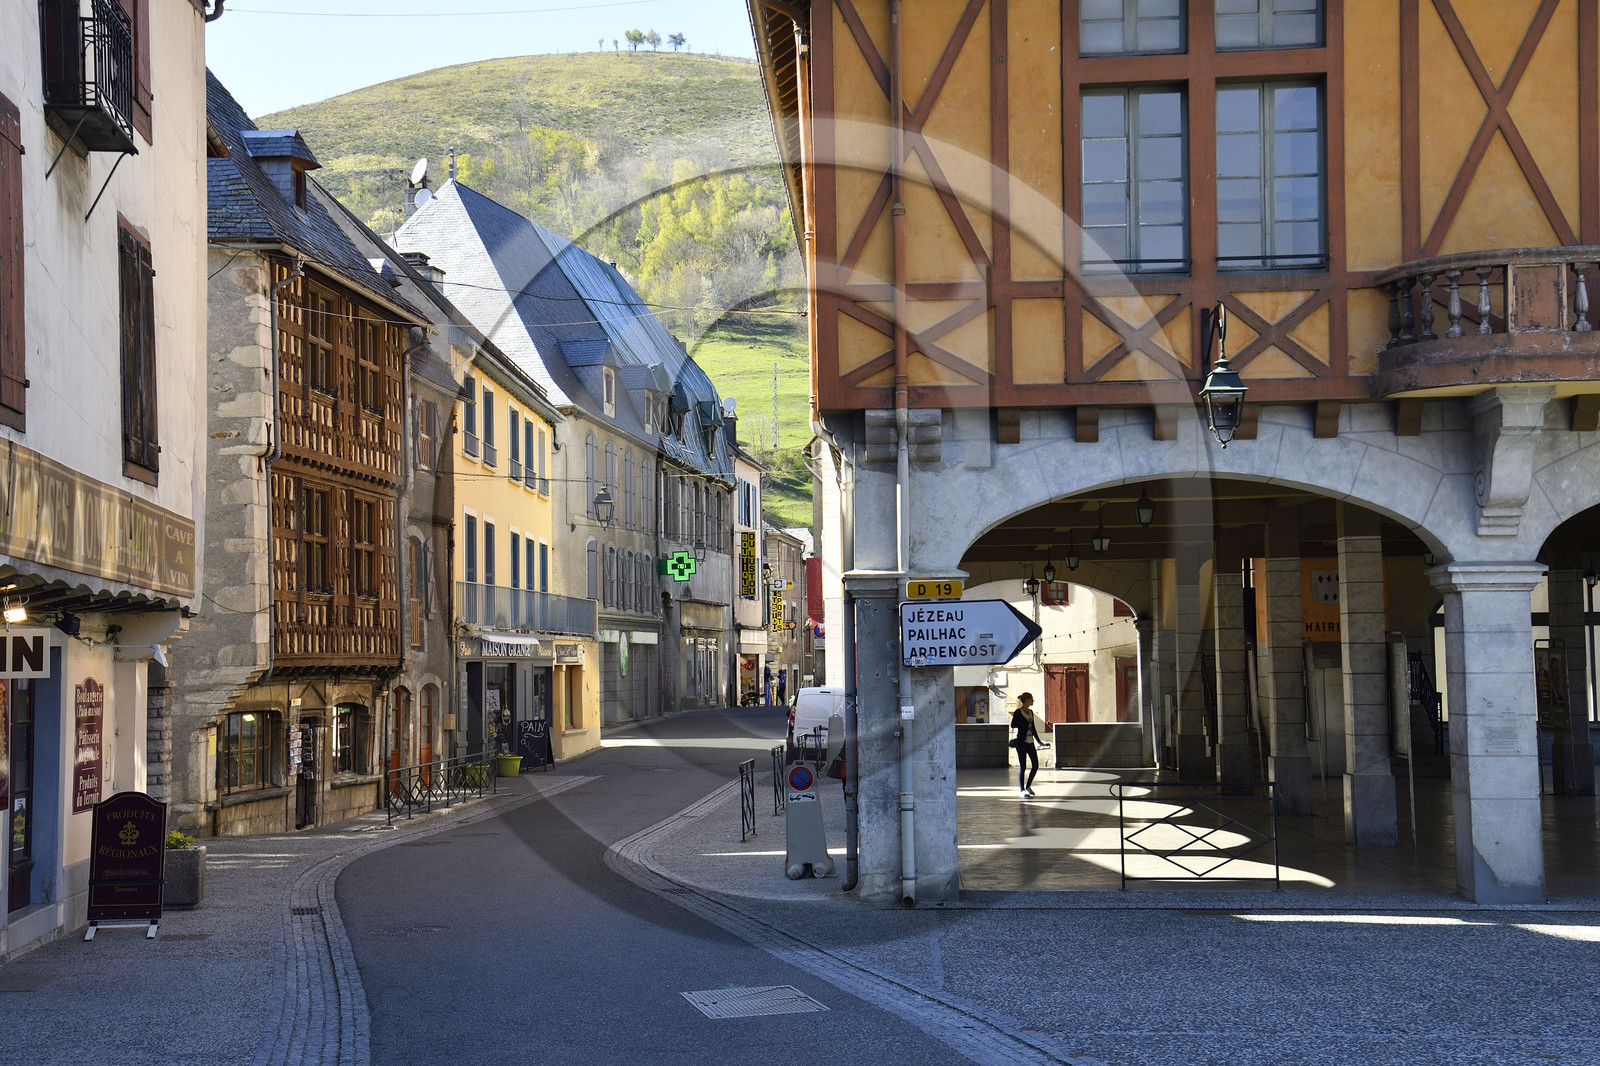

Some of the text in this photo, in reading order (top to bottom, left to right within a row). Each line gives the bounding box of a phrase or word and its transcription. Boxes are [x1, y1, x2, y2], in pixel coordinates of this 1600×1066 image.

[165, 524, 194, 546] CAVE
[175, 550, 184, 564] A
[169, 569, 189, 586] VIN
[918, 583, 952, 596] D 19
[908, 608, 964, 623] JÉZEAU
[908, 627, 966, 641] PAILHAC
[1305, 622, 1340, 632] MAIRI
[0, 636, 43, 671] IN
[482, 641, 507, 657] MAISON
[910, 644, 997, 659] ARDENGOST
[76, 688, 103, 707] Boulangerie
[520, 720, 547, 732] PAIN
[79, 774, 98, 791] Produits
[76, 789, 99, 807] du Terroir
[106, 809, 157, 821] PRODUITS
[98, 844, 159, 859] RÉGIONAUX
